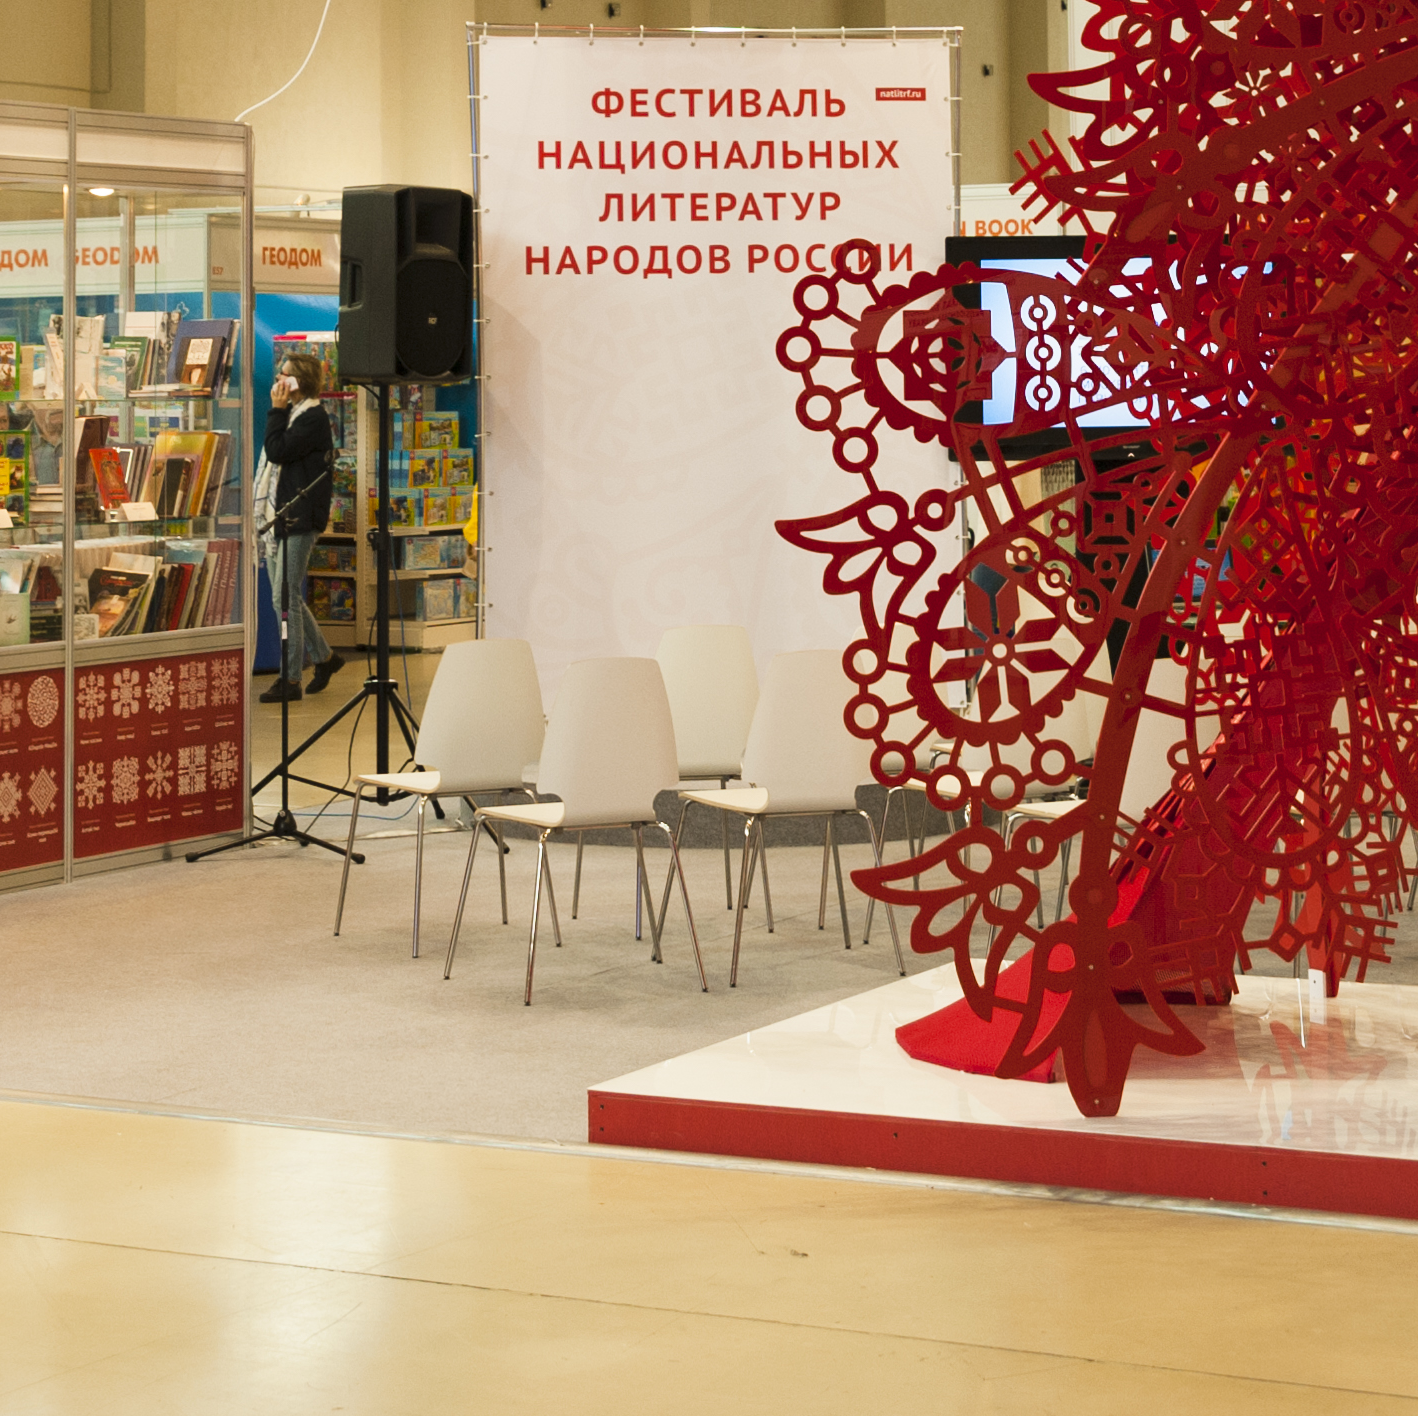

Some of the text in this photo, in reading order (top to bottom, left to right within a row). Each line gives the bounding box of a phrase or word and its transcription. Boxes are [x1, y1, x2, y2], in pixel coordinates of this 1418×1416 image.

[591, 87, 846, 118] ФЕСТИВАЛЬ
[537, 140, 900, 174] НАЦИОНАЛЬНЫХ
[599, 191, 841, 222] ЛИТЕРАТУР
[262, 245, 322, 268] ГЕОДОМ
[525, 243, 731, 279] НАРОДОВ
